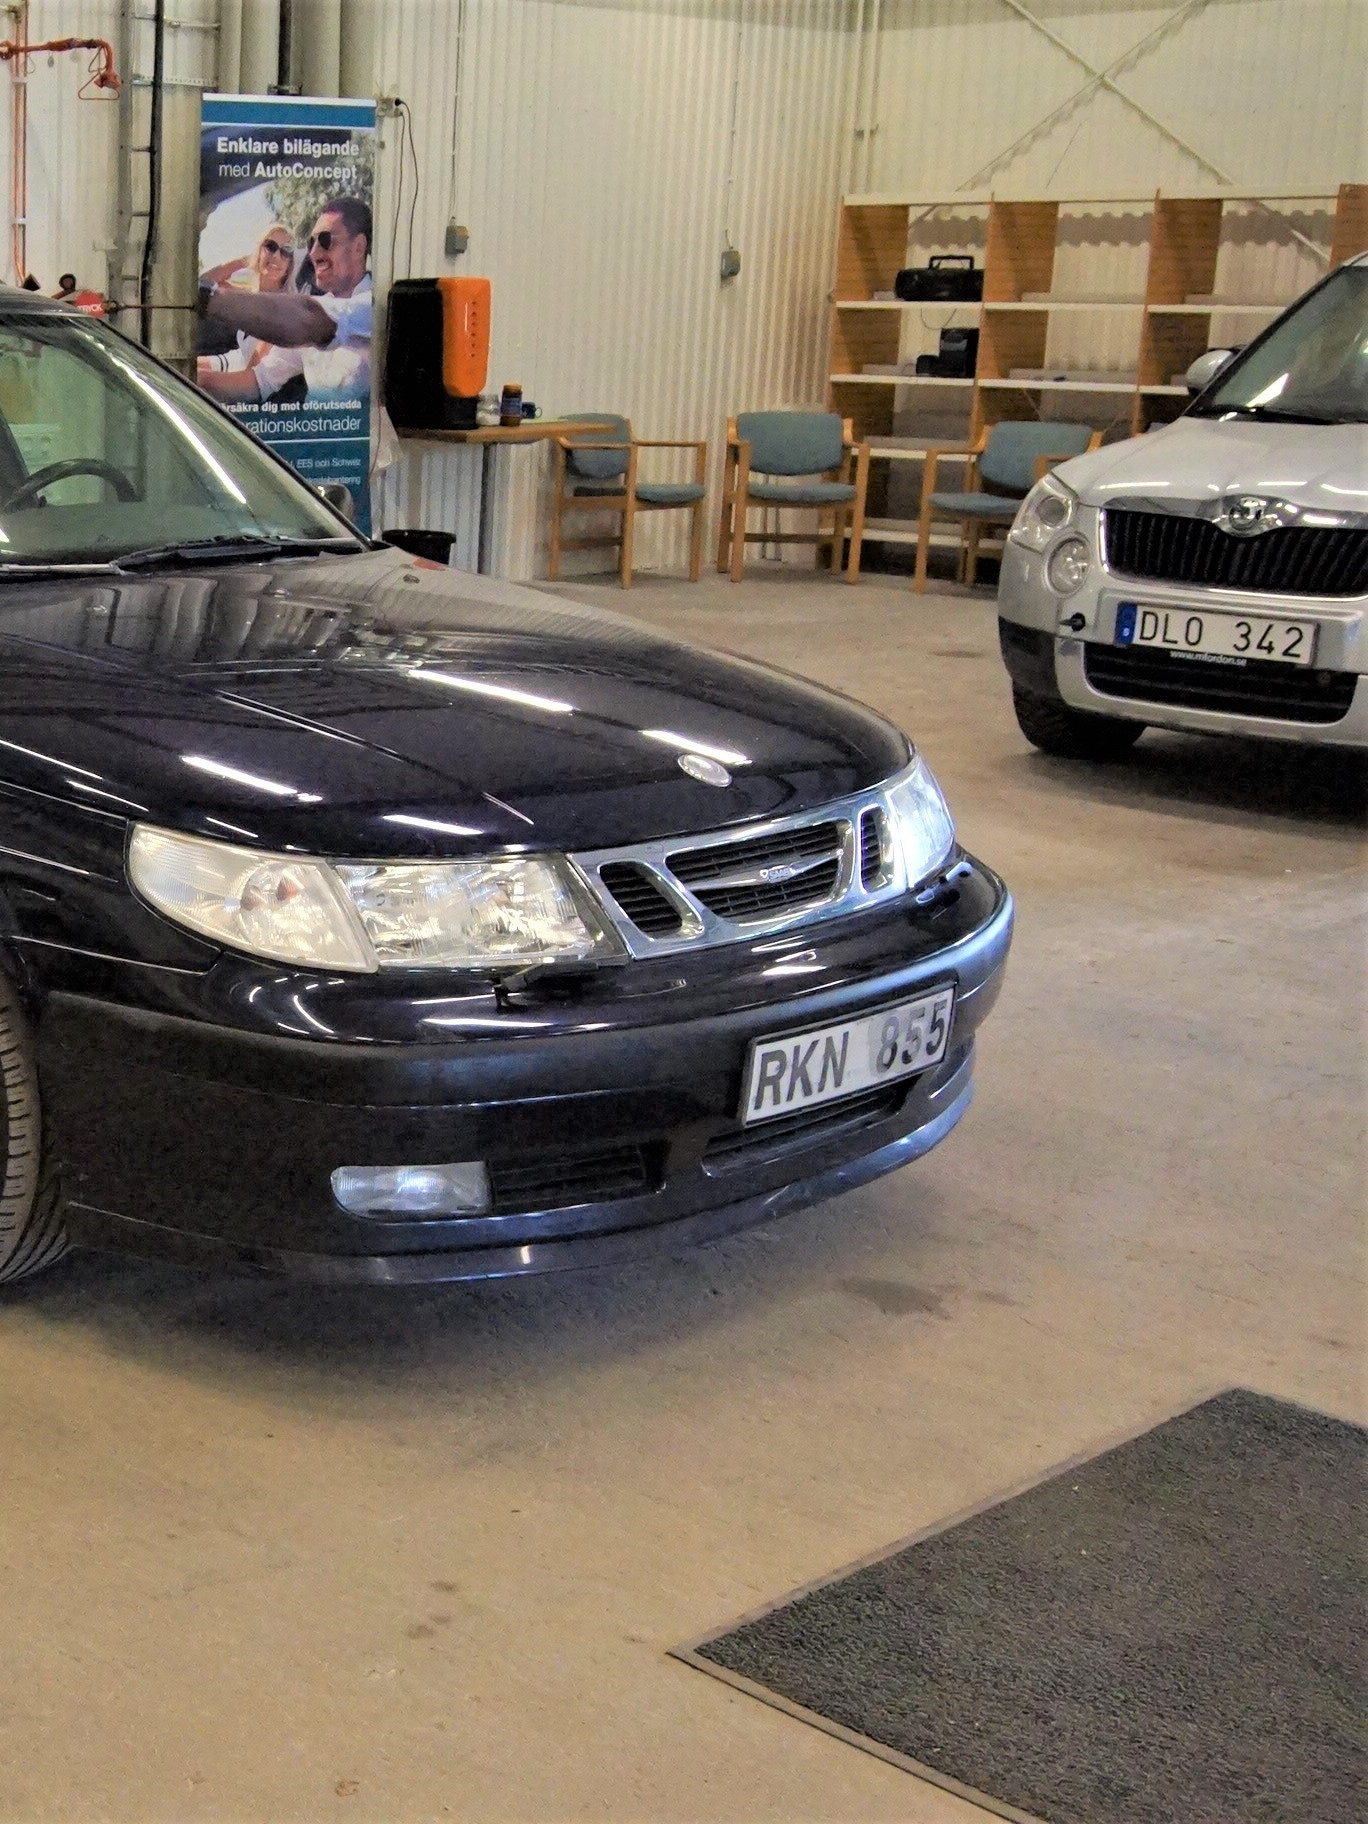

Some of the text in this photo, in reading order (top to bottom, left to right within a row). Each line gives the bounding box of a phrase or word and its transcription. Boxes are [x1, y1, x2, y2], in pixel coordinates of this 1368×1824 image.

[217, 136, 360, 158] Enklare bilägande
[218, 161, 358, 181] med AutoConcept
[261, 401, 278, 413] dig
[281, 401, 300, 411] mot
[303, 400, 362, 411] oförutsedda
[296, 458, 313, 469] EES
[315, 458, 330, 468] och
[1122, 627, 1131, 637] S
[1139, 610, 1304, 658] DLO 342
[754, 999, 949, 1110] RKN 855
